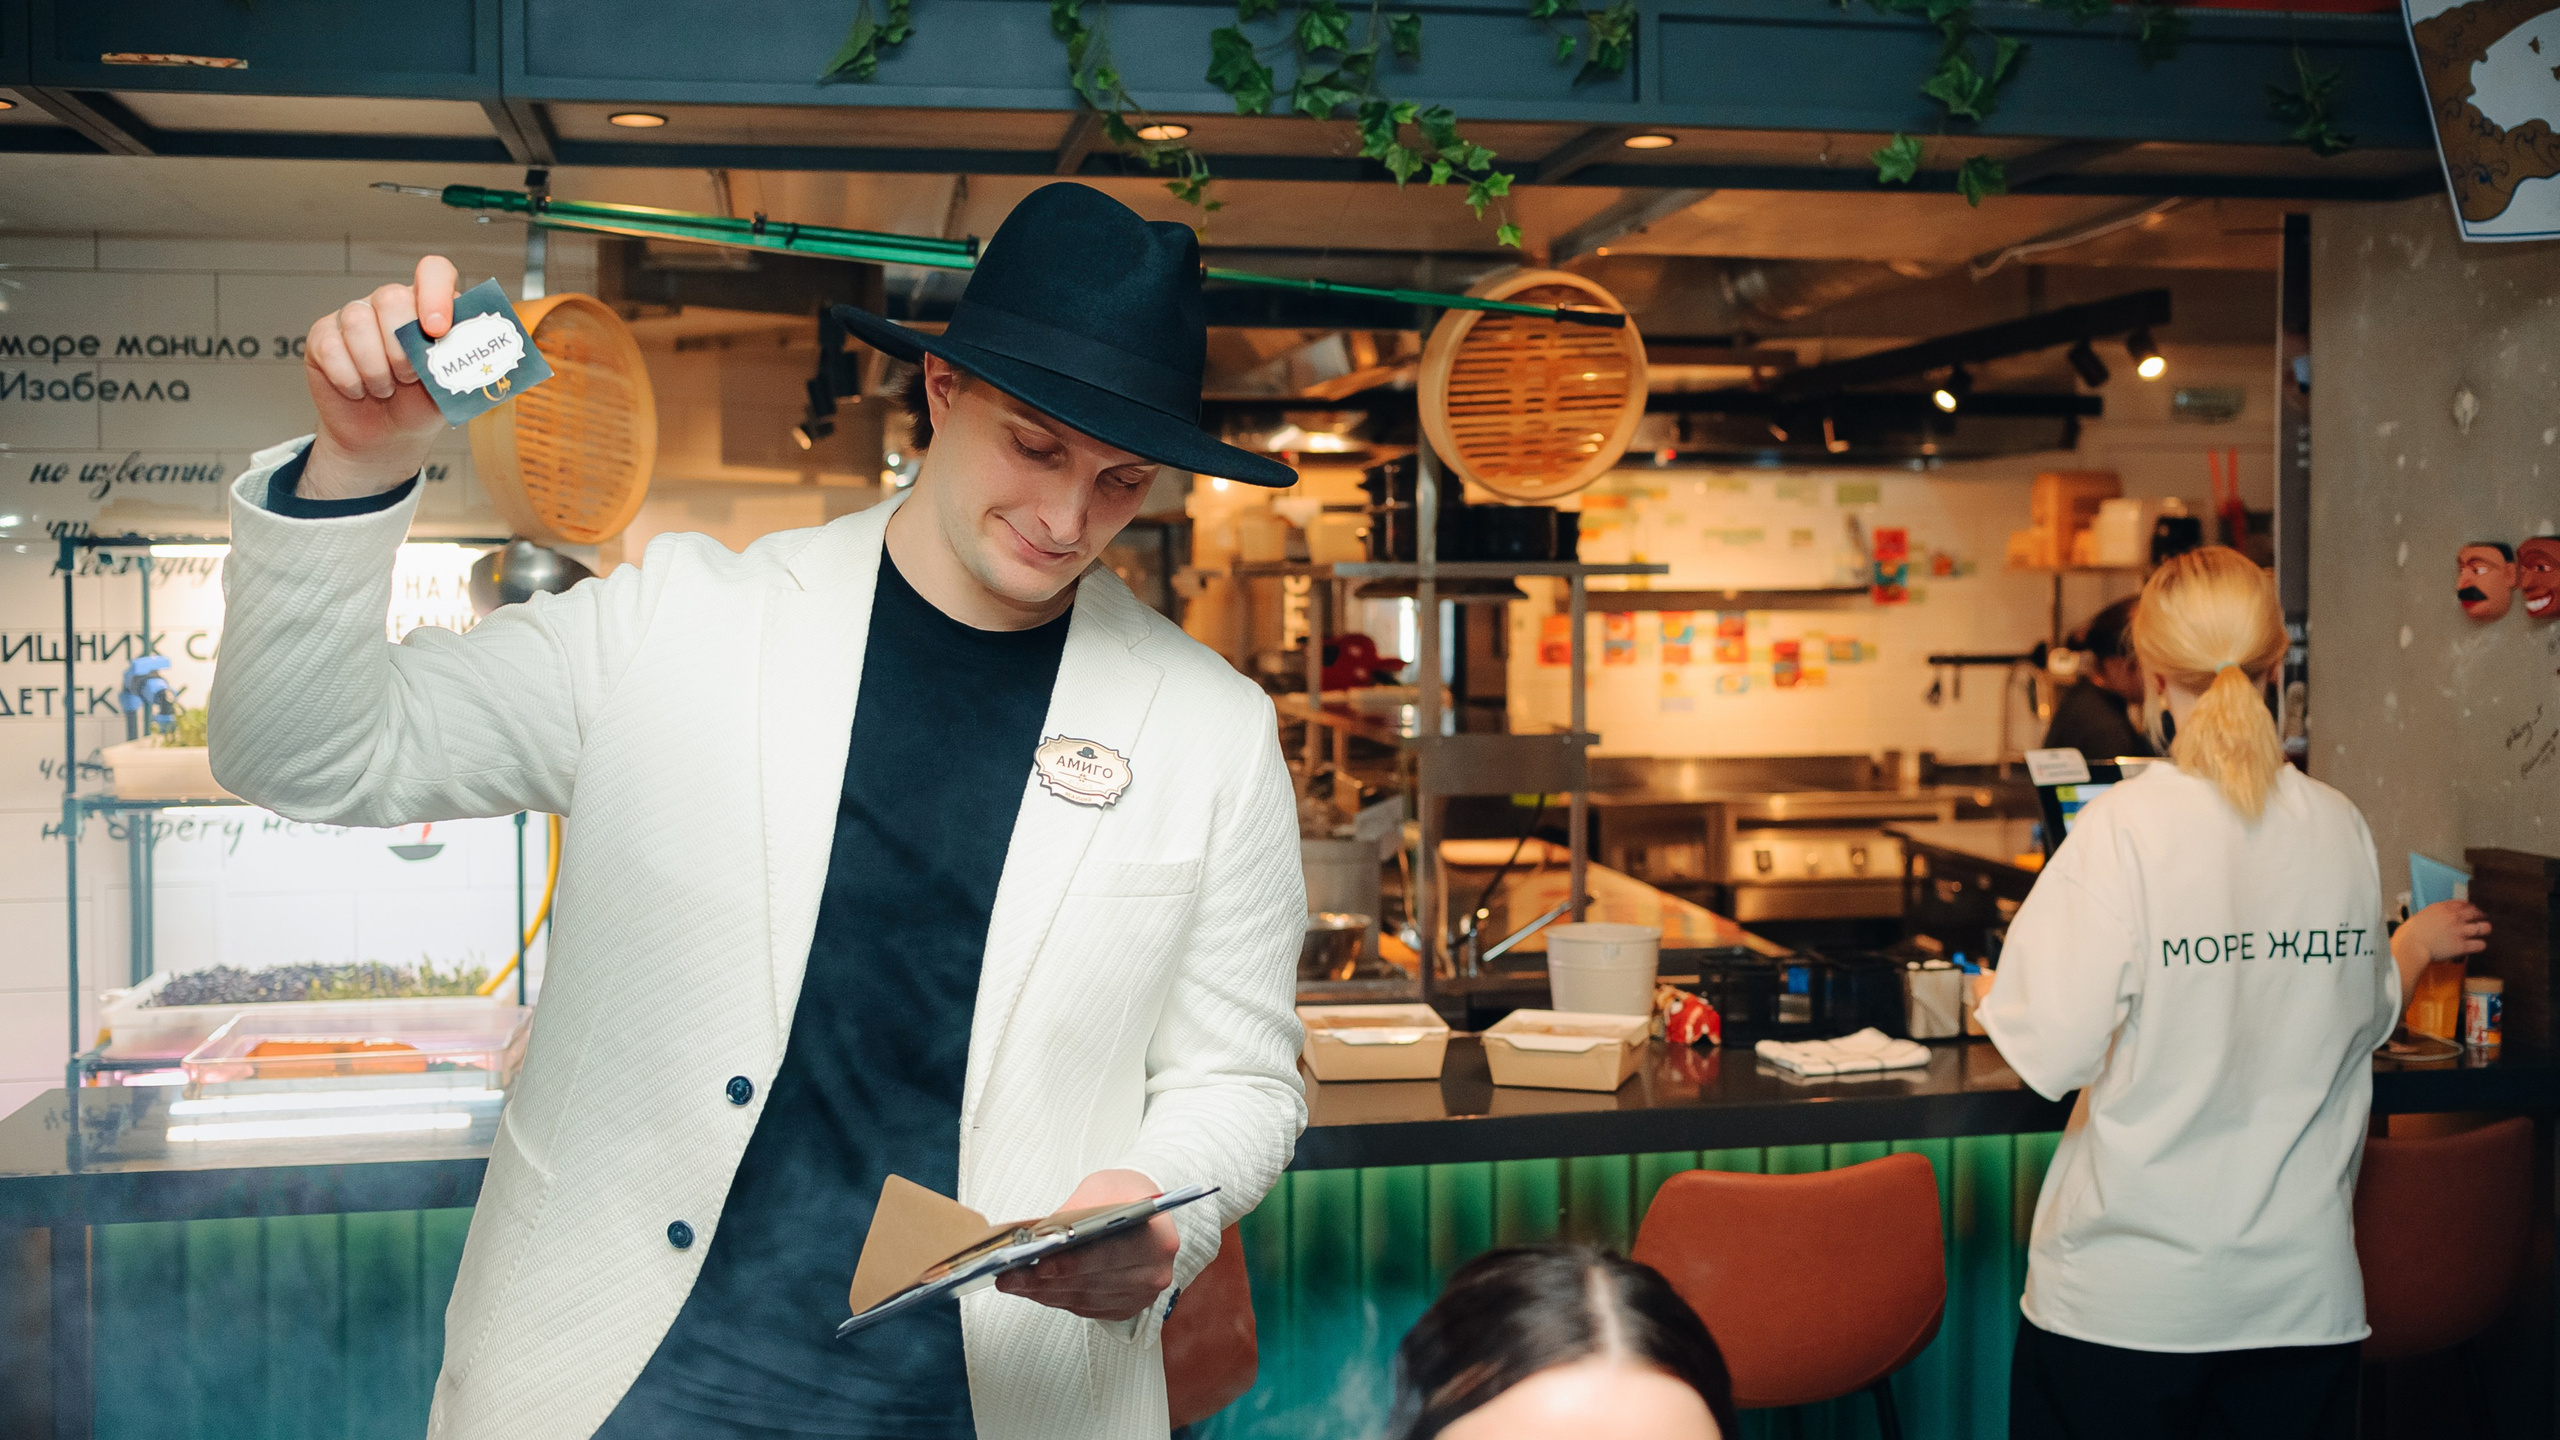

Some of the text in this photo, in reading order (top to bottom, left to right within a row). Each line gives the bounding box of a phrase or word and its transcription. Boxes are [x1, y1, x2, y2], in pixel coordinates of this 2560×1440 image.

[0, 335, 100, 365] море
[116, 335, 259, 358] манило
[441, 332, 512, 377] МАНЬЯК
[0, 371, 190, 401] Изабелла
[1056, 755, 1113, 779] АМИГО
[2162, 932, 2255, 967] МОРЕ
